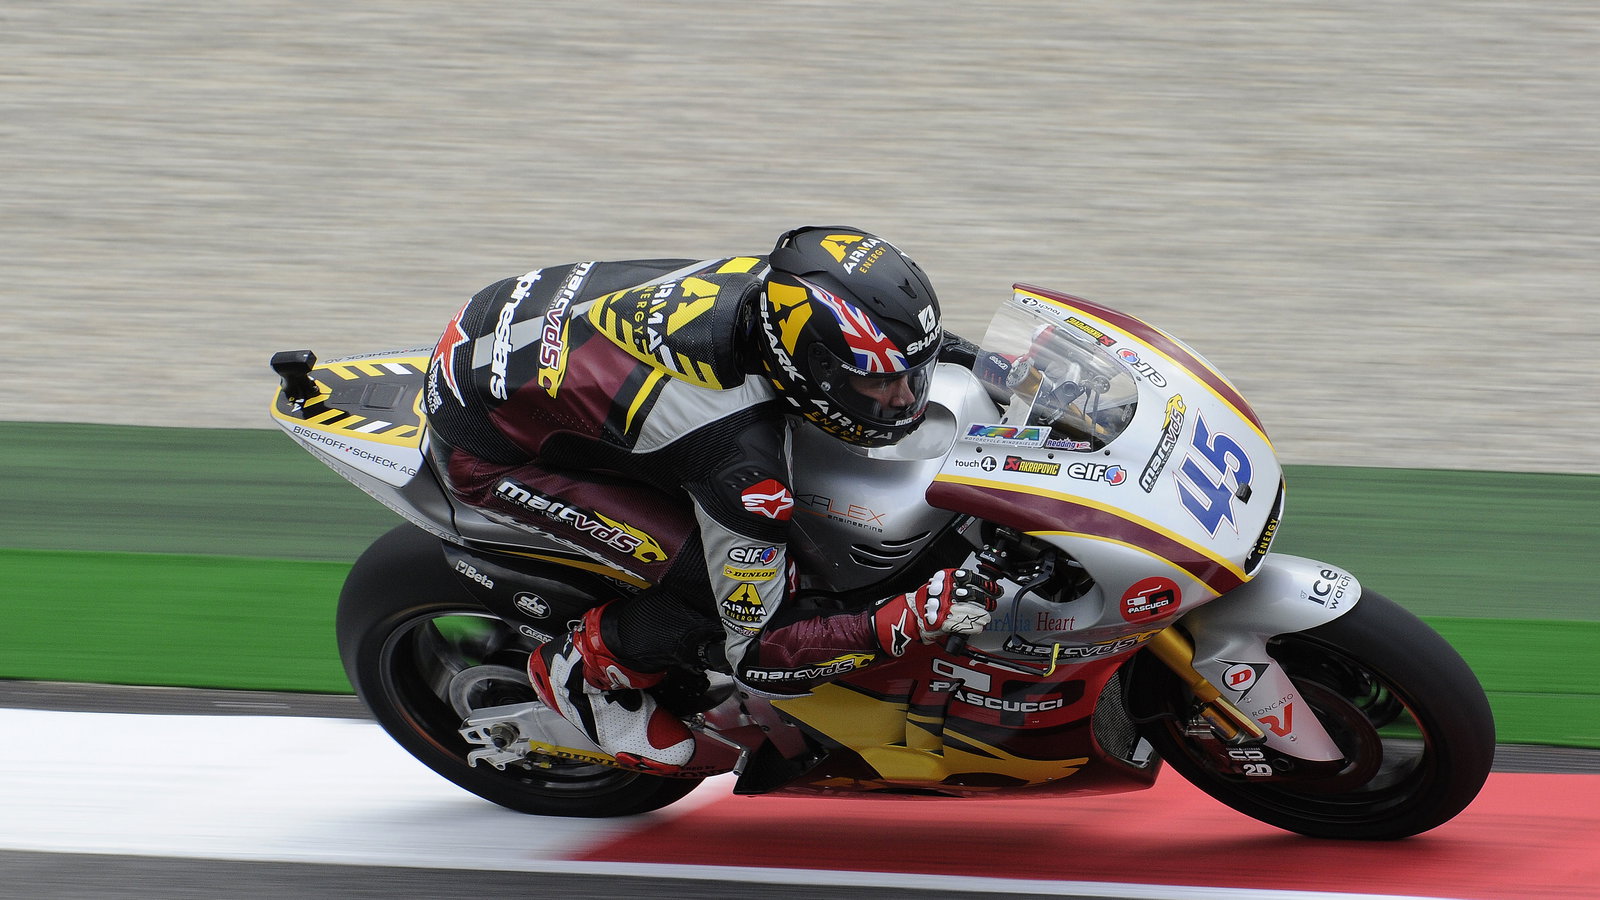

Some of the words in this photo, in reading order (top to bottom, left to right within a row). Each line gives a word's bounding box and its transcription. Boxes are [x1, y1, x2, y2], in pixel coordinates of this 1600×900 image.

[859, 246, 887, 274] ENERGY
[490, 267, 544, 401] lpinestars
[760, 291, 807, 382] SHARK
[840, 363, 869, 377] SHARK
[967, 424, 1040, 441] MRA
[293, 425, 346, 451] BISCHOFF
[352, 446, 398, 471] SCHECK
[399, 466, 417, 477] AG
[1141, 407, 1184, 490] marcvds
[955, 459, 980, 468] touch
[1067, 463, 1106, 481] elf
[1172, 407, 1255, 541] 45
[497, 480, 643, 554] marcvds
[793, 491, 886, 527] KALEX
[1257, 518, 1278, 554] ENERGY
[728, 547, 763, 563] elf
[465, 565, 495, 590] Beta
[733, 570, 776, 578] DUNLOP
[1329, 574, 1352, 610] watch
[517, 595, 548, 615] sbs
[721, 600, 768, 616] ARMA
[725, 609, 759, 622] ENERGY
[1128, 599, 1169, 614] PASCUCCI
[1036, 611, 1076, 631] Heart
[746, 658, 855, 680] marcvds
[929, 681, 1064, 713] PASCUCCI
[1251, 693, 1294, 718] RONCATO
[1243, 763, 1273, 777] 2D
